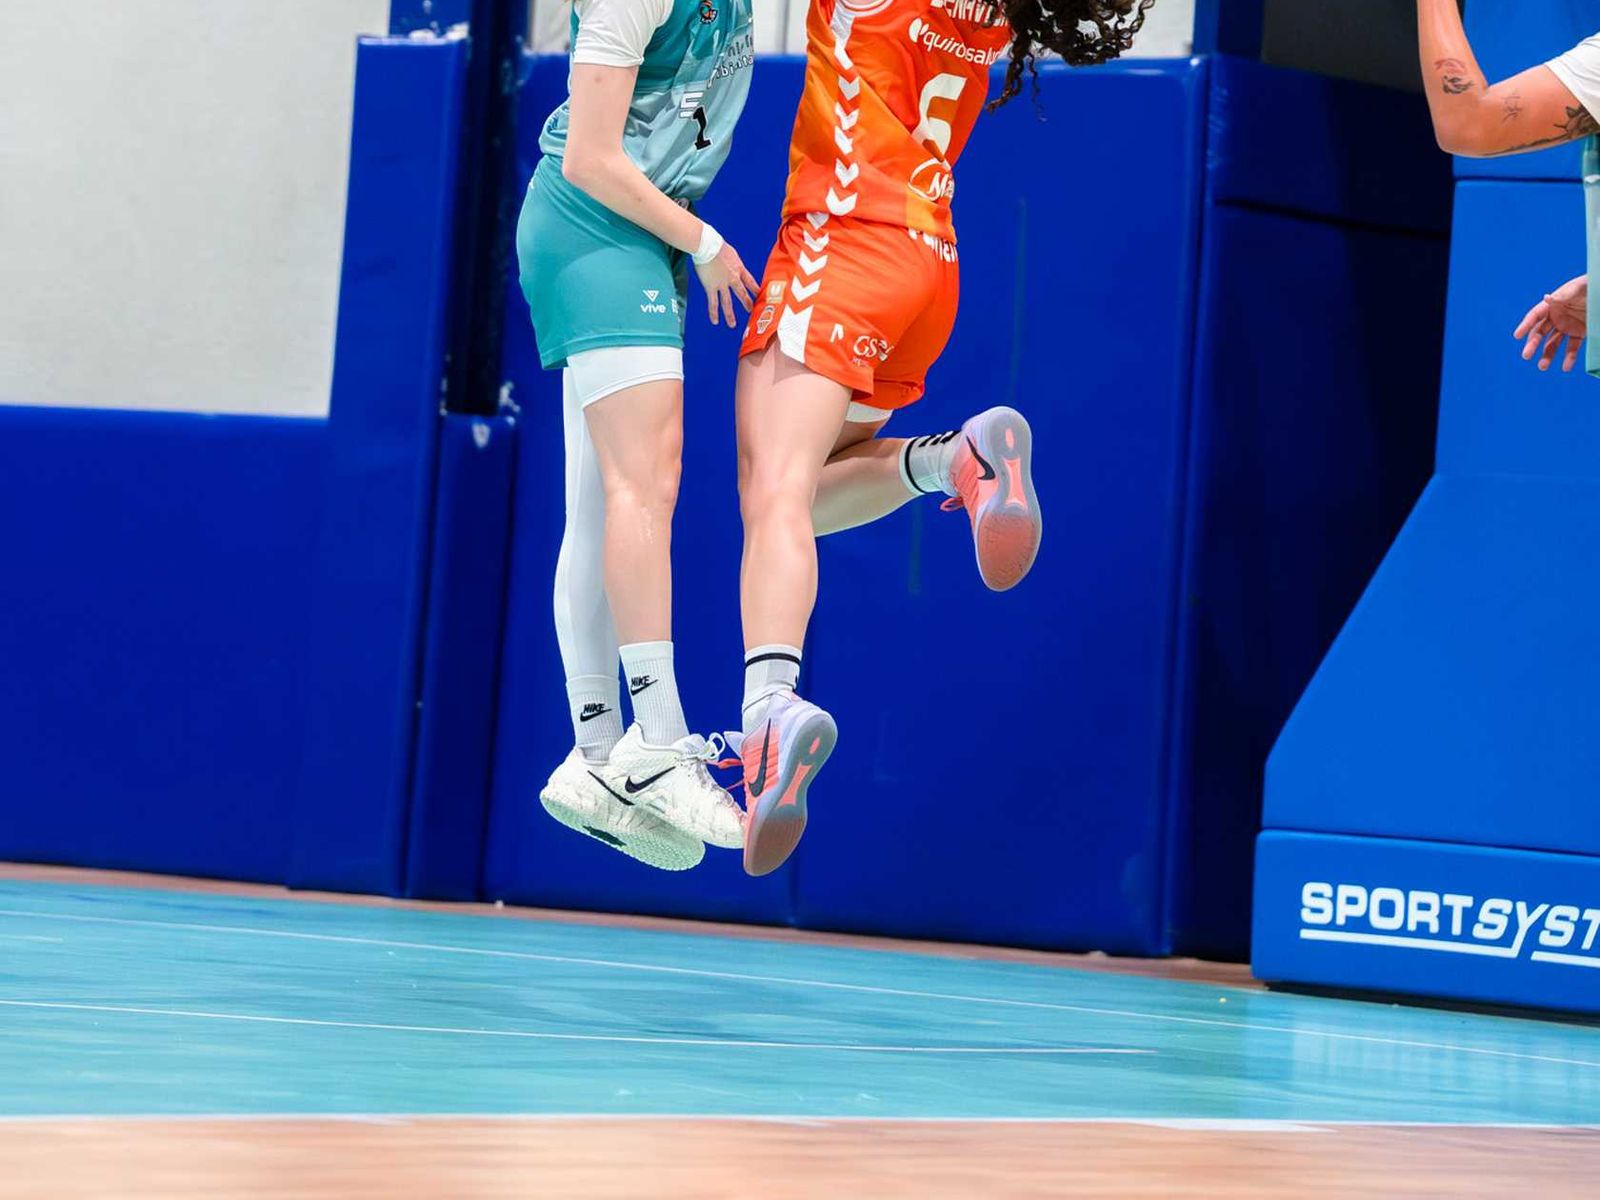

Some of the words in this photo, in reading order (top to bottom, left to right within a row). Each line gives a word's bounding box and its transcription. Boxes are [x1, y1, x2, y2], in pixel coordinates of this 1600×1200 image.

[640, 303, 667, 314] vive
[631, 675, 650, 687] NIKE
[583, 703, 605, 714] NIKE
